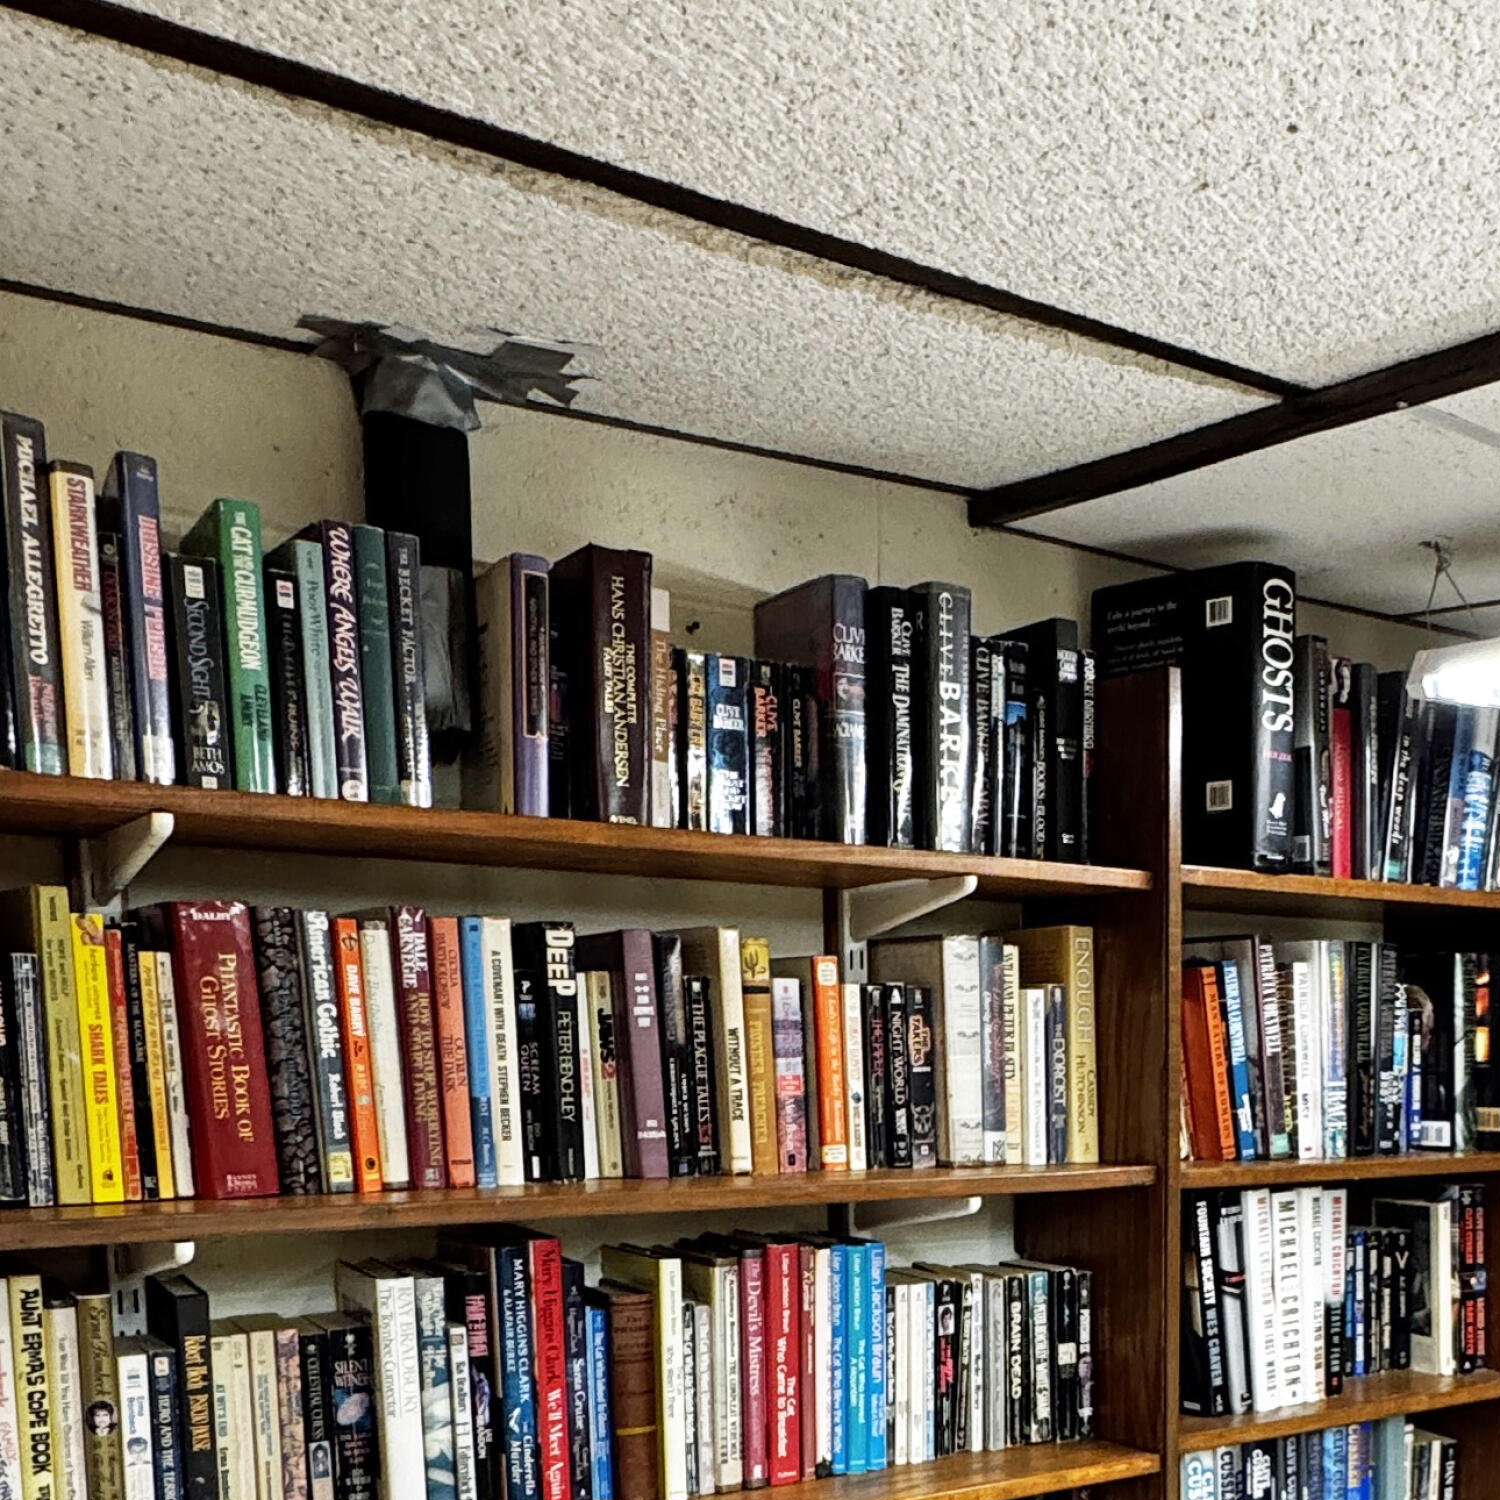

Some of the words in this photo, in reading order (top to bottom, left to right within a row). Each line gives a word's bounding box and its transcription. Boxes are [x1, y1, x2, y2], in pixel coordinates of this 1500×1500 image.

[16, 434, 35, 529] MICHAEL
[66, 477, 92, 592] STARKWEATHER
[138, 516, 163, 600] MISSING
[231, 526, 252, 553] CAT
[330, 528, 352, 595] WHERE
[22, 534, 49, 665] ALLEGRETTO
[235, 569, 262, 668] CURMUDGEON
[611, 576, 623, 620] HANS
[143, 604, 168, 680] PERSON
[332, 599, 357, 677] ANGELS
[938, 592, 953, 681] CLIVE
[1262, 578, 1293, 732] GHOSTS
[611, 622, 626, 705] CHRISTIAN
[340, 676, 361, 741] WALK
[754, 686, 767, 739] BARKER
[766, 686, 778, 732] CLIVE
[614, 706, 630, 788] ANDERSEN
[307, 911, 329, 1003] American
[399, 915, 418, 988] CARNEGIE
[415, 931, 428, 972] DALE
[546, 931, 576, 997] DEEP
[346, 964, 358, 998] DAVE
[491, 958, 501, 1002] COVENANT
[1075, 937, 1092, 1043] ENOUGH
[200, 976, 218, 1037] GHOST
[218, 953, 244, 1061] PHANTASTIC
[316, 1003, 339, 1058] Gothic
[349, 999, 365, 1037] BARRY
[494, 1005, 503, 1031] WITH
[558, 1011, 572, 1050] PETER
[88, 1023, 104, 1065] SHARK
[496, 1032, 505, 1061] DEATH
[728, 1027, 741, 1075] WITHOUT
[912, 1015, 924, 1066] TAKERS
[93, 1070, 108, 1105] TALES
[207, 1043, 230, 1121] STORIES
[498, 1066, 508, 1104] STEPHEN
[520, 1044, 531, 1092] QUEEN
[529, 1042, 541, 1095] SCREAM
[558, 1050, 575, 1122] BENCHLEY
[1053, 1038, 1066, 1107] EXORCIST
[732, 1088, 744, 1121] TRACE
[1076, 1055, 1088, 1134] HUTCHINSON
[501, 1106, 512, 1142] BECKER
[1278, 1200, 1296, 1289] MICHAEL
[512, 1258, 525, 1297] MARY
[515, 1300, 528, 1355] HIGGINS
[748, 1281, 762, 1331] Devil's
[1010, 1301, 1022, 1352] BRAIN
[1206, 1307, 1219, 1335] WES
[749, 1336, 763, 1396] Mistress
[1209, 1338, 1224, 1386] CRAVEN
[1282, 1296, 1301, 1387] CRICHTON
[20, 1289, 42, 1328] AUNT
[31, 1433, 51, 1475] BOOK
[518, 1357, 530, 1403] CLARK
[572, 1358, 585, 1390] Santa
[1010, 1356, 1022, 1399] DEAD
[158, 1395, 171, 1424] HERO
[547, 1388, 562, 1422] We'll
[573, 1391, 586, 1430] Cruise
[161, 1425, 173, 1446] AND
[162, 1449, 174, 1468] THE
[549, 1424, 563, 1455] Meet
[511, 1441, 523, 1484] Murder
[523, 1436, 535, 1496] Cinderella
[549, 1461, 565, 1500] Again
